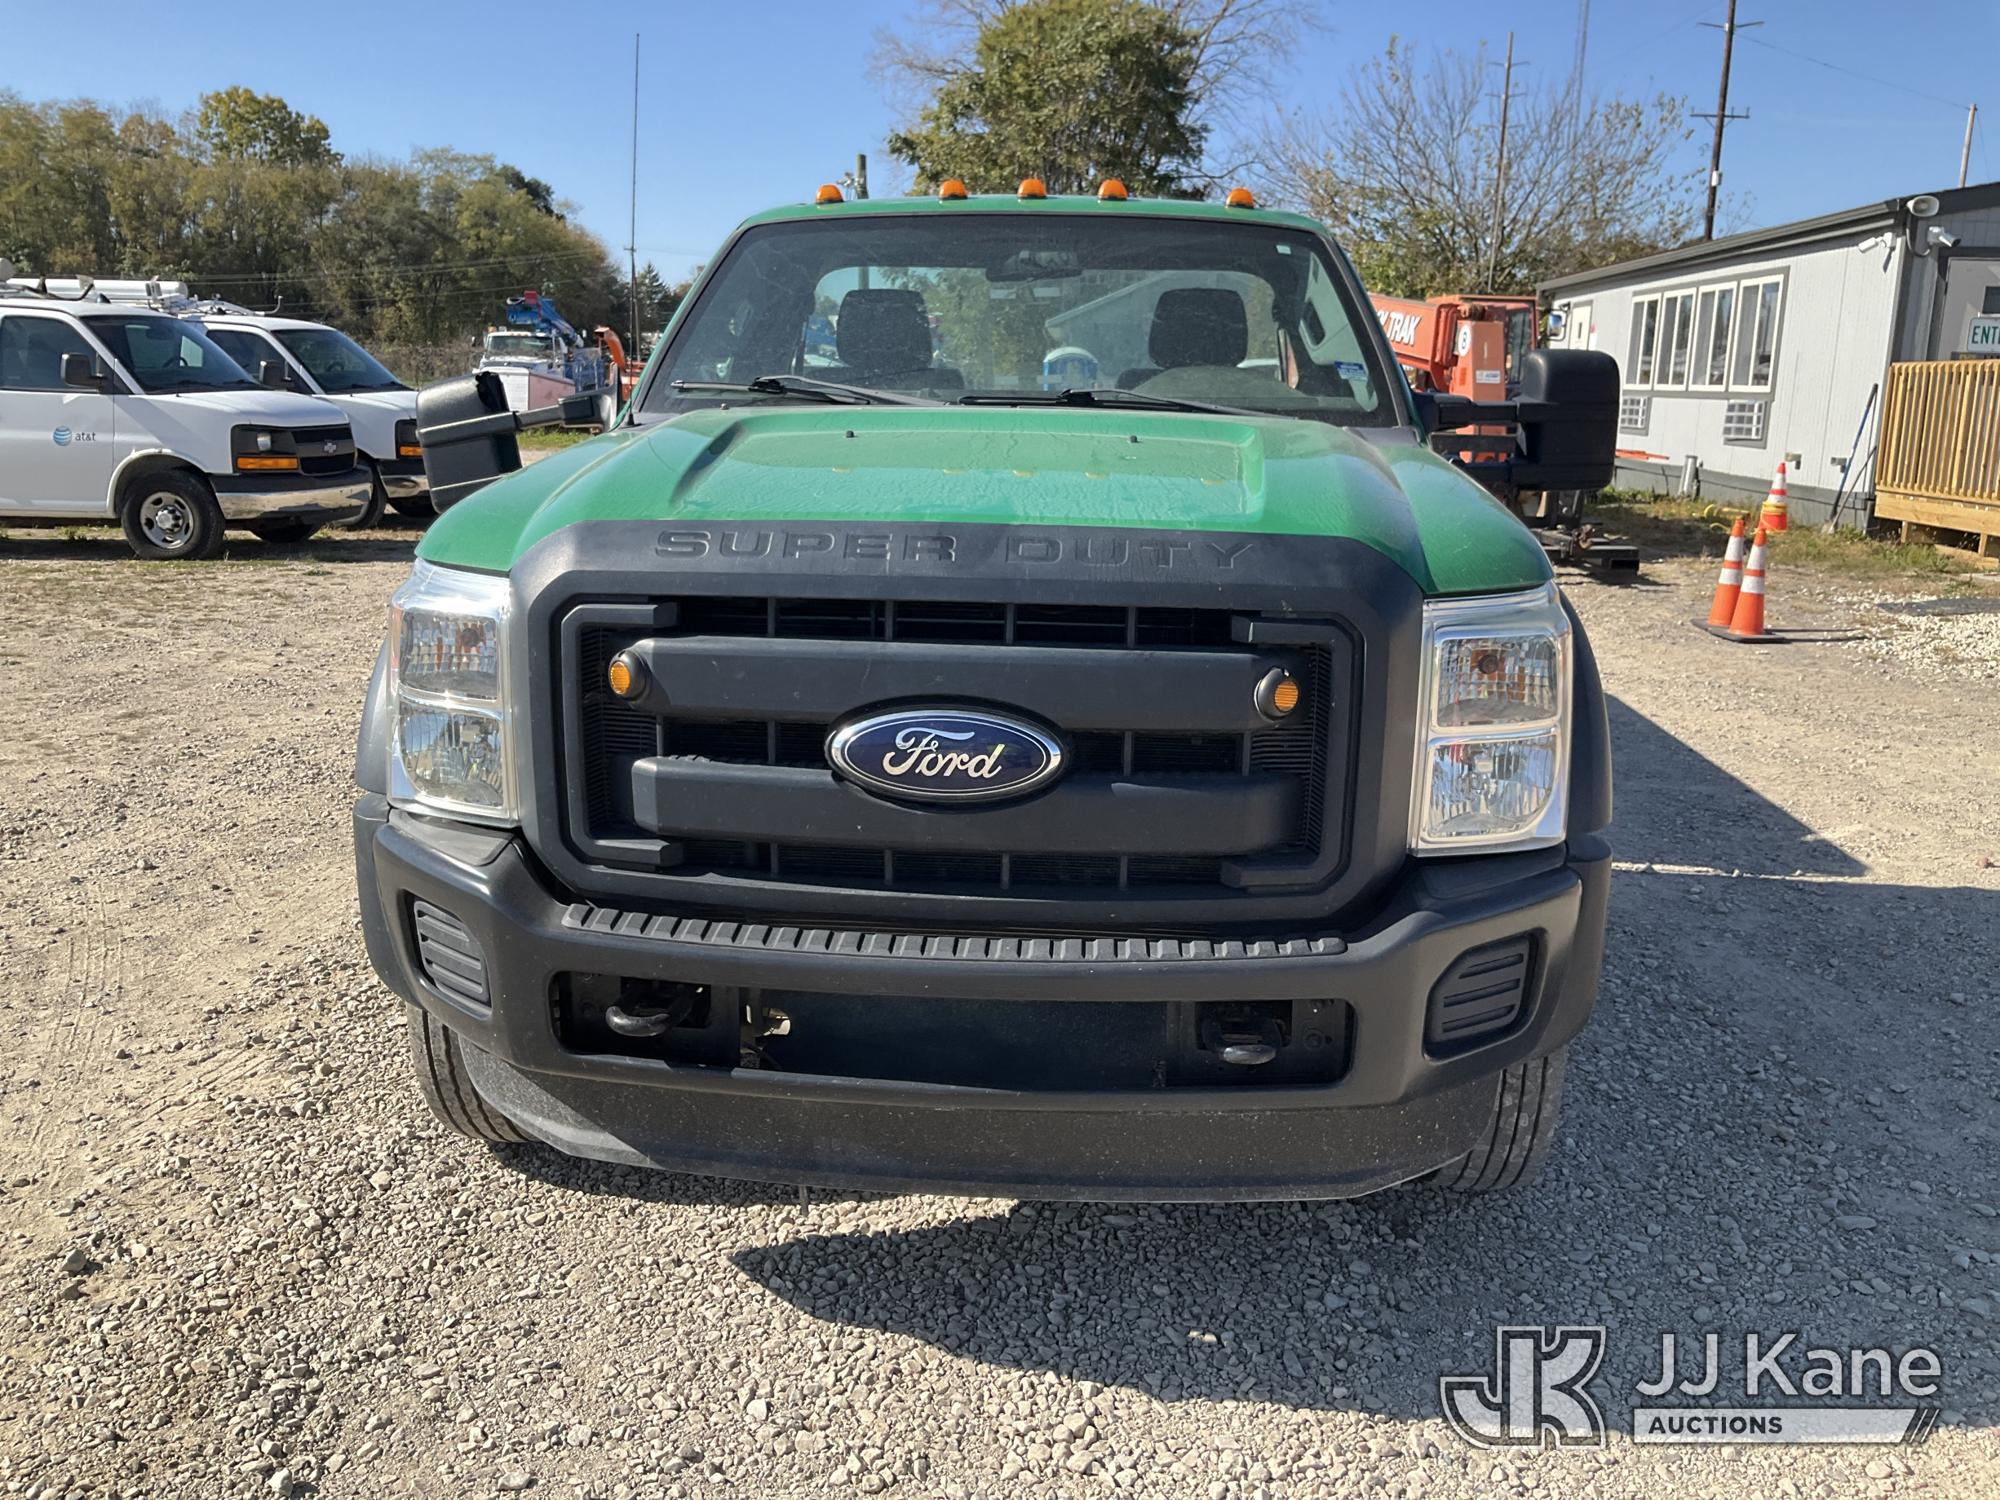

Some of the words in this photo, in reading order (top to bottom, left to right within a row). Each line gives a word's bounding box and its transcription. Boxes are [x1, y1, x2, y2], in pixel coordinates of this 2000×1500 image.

[1386, 311, 1422, 347] TRAK
[1971, 325, 2000, 345] ENT
[74, 431, 97, 442] at&t
[654, 530, 957, 562] SUPER
[1005, 536, 1253, 569] DUTY
[882, 727, 1005, 779] Ford
